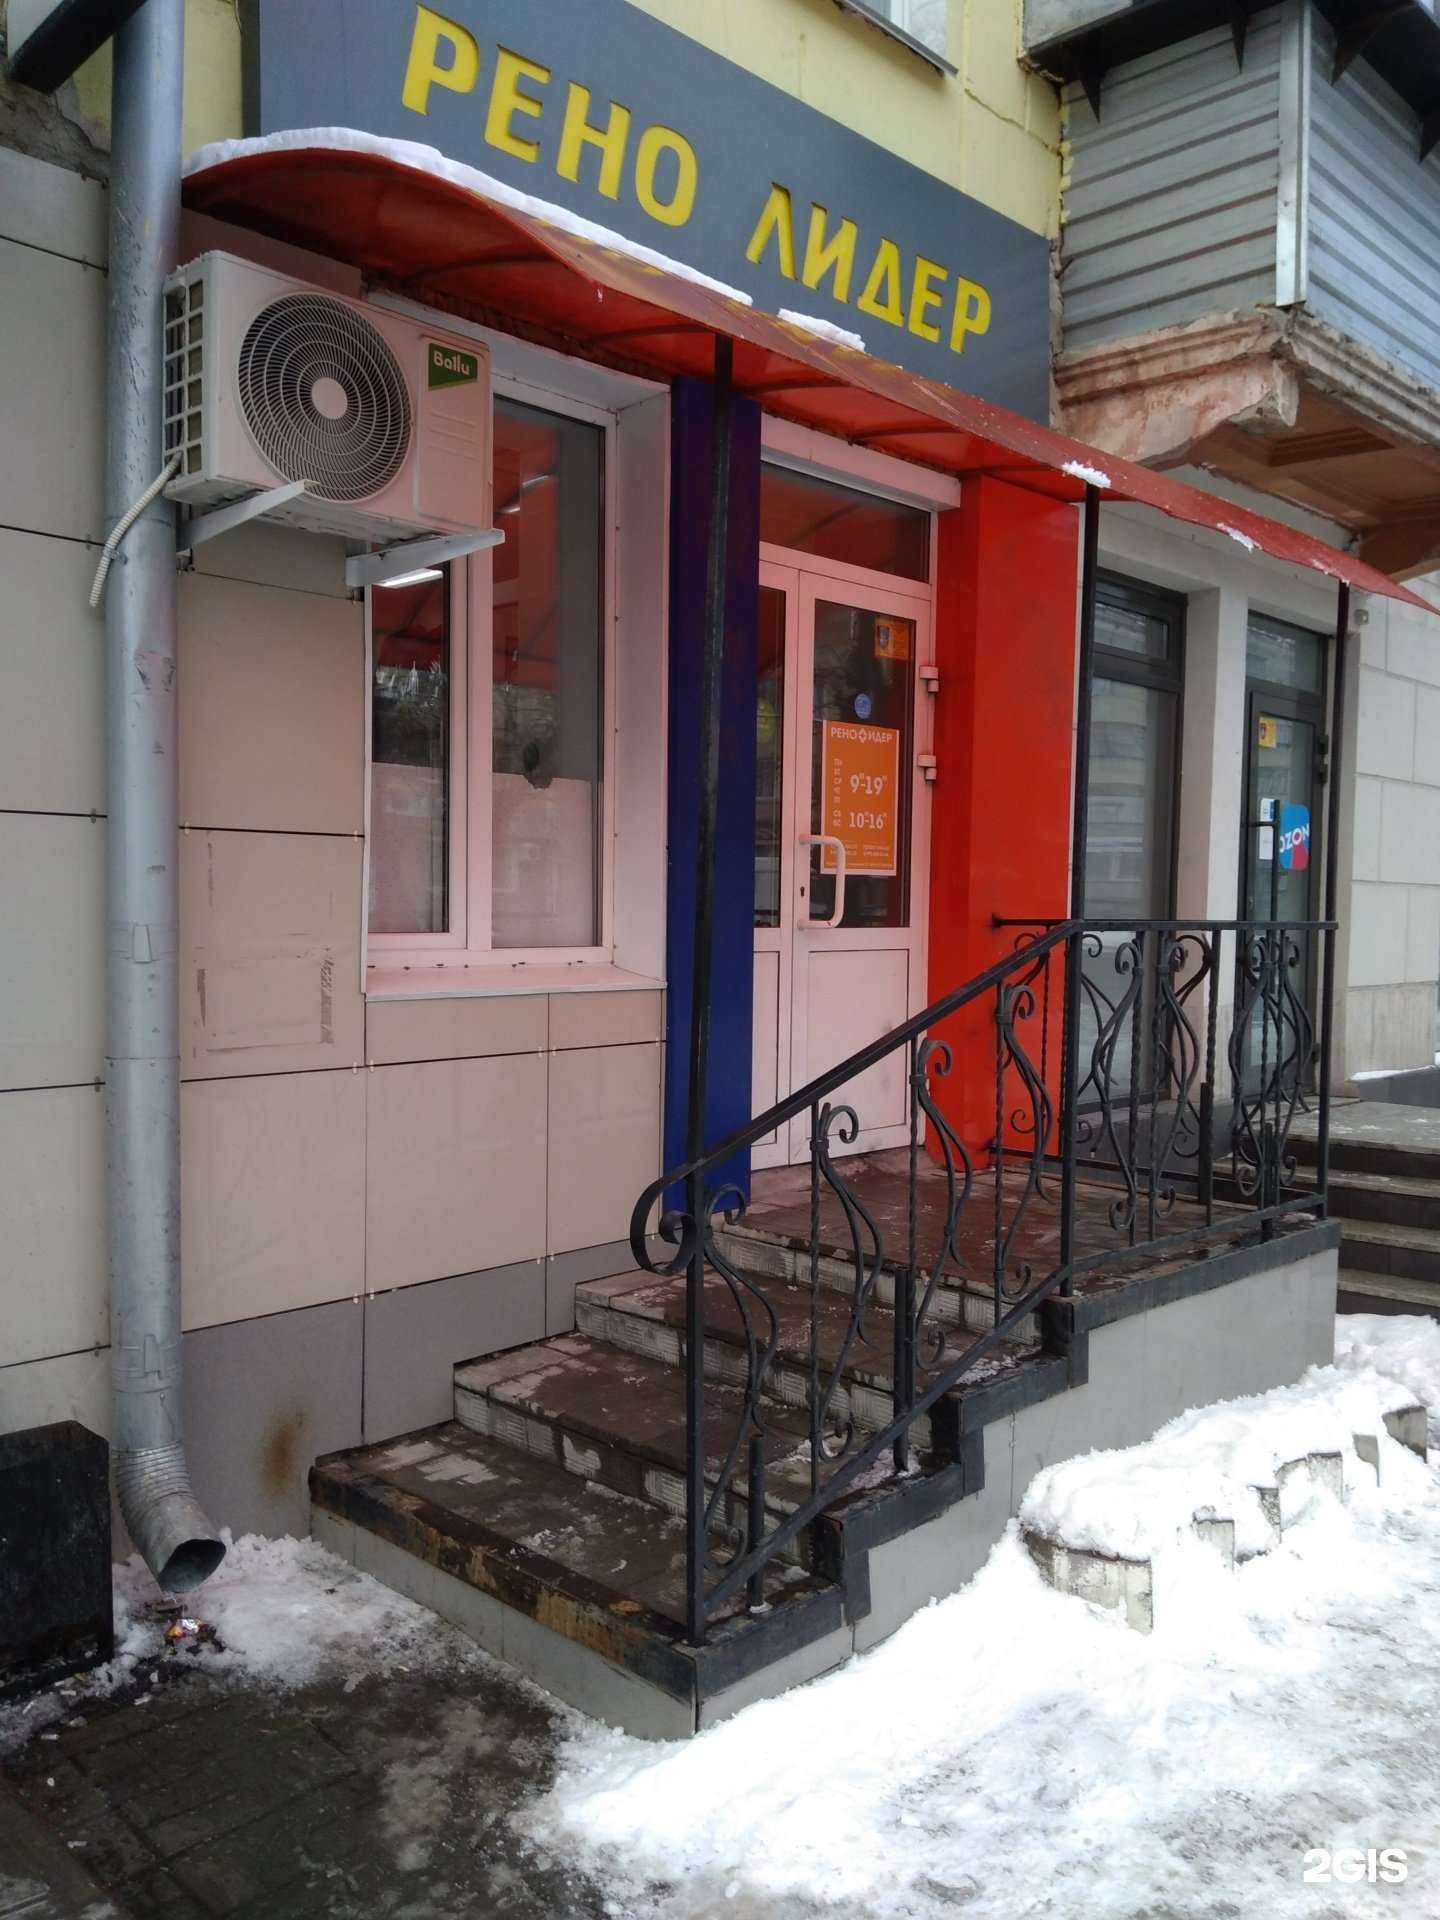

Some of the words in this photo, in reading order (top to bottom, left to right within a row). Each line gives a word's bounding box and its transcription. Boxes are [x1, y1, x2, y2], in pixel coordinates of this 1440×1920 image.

[401, 5, 698, 226] РЕНО
[746, 182, 992, 354] ЛИДЕР
[433, 350, 470, 376] Ballu
